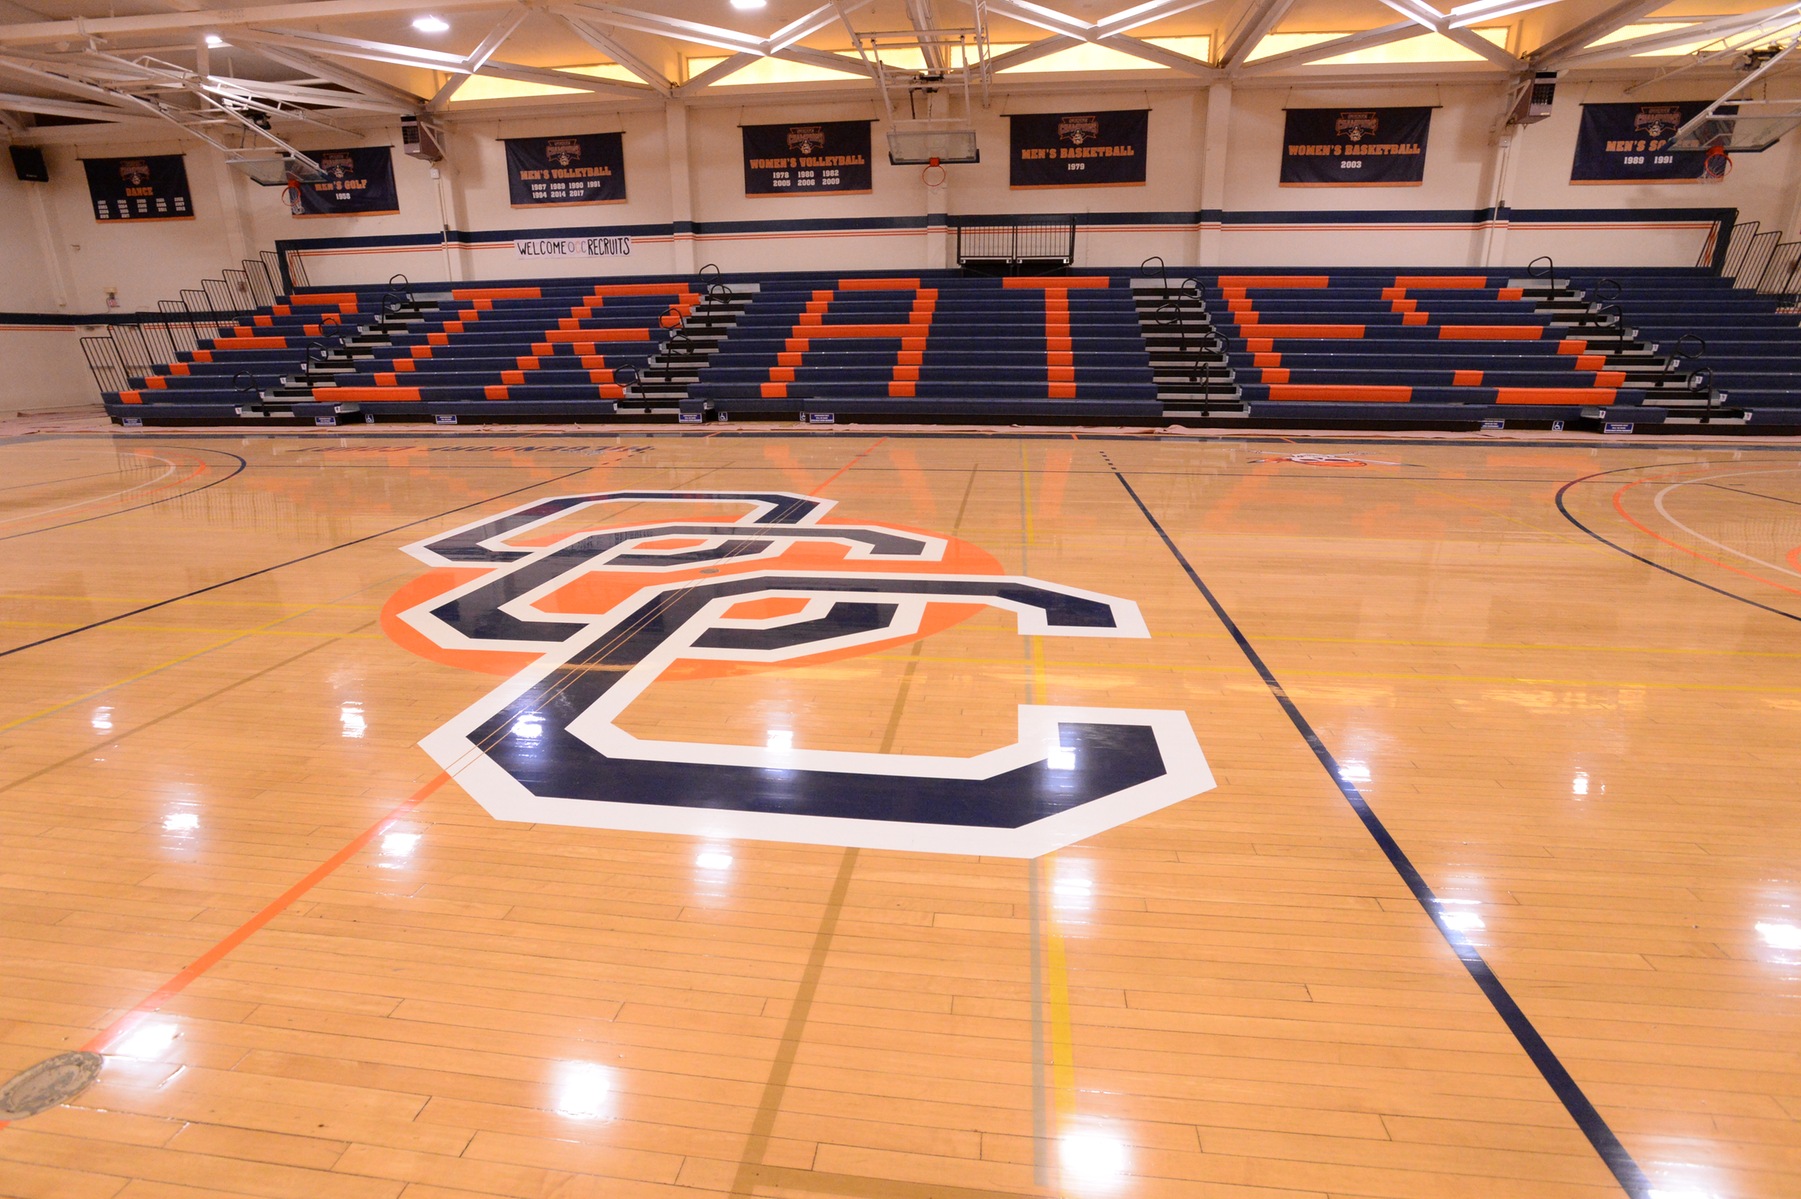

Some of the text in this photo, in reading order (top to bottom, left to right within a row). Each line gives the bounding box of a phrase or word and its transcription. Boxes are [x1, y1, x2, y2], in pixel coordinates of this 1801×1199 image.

[1288, 143, 1421, 156] WOMEN'S BASKETBALL
[1605, 140, 1646, 152] MEN'S
[1021, 145, 1135, 160] MEN'S BASKETBALL
[749, 154, 865, 169] WOMEN'S VOLLEYBALL
[1340, 160, 1362, 169] 2003
[1623, 155, 1674, 164] 1989 1991
[520, 166, 612, 180] MEN'S VOLLEYBALL
[314, 179, 368, 191] MEN'S GOLF
[125, 186, 154, 197] DANCE
[517, 237, 630, 256] WELCOME OCC RECRUITS
